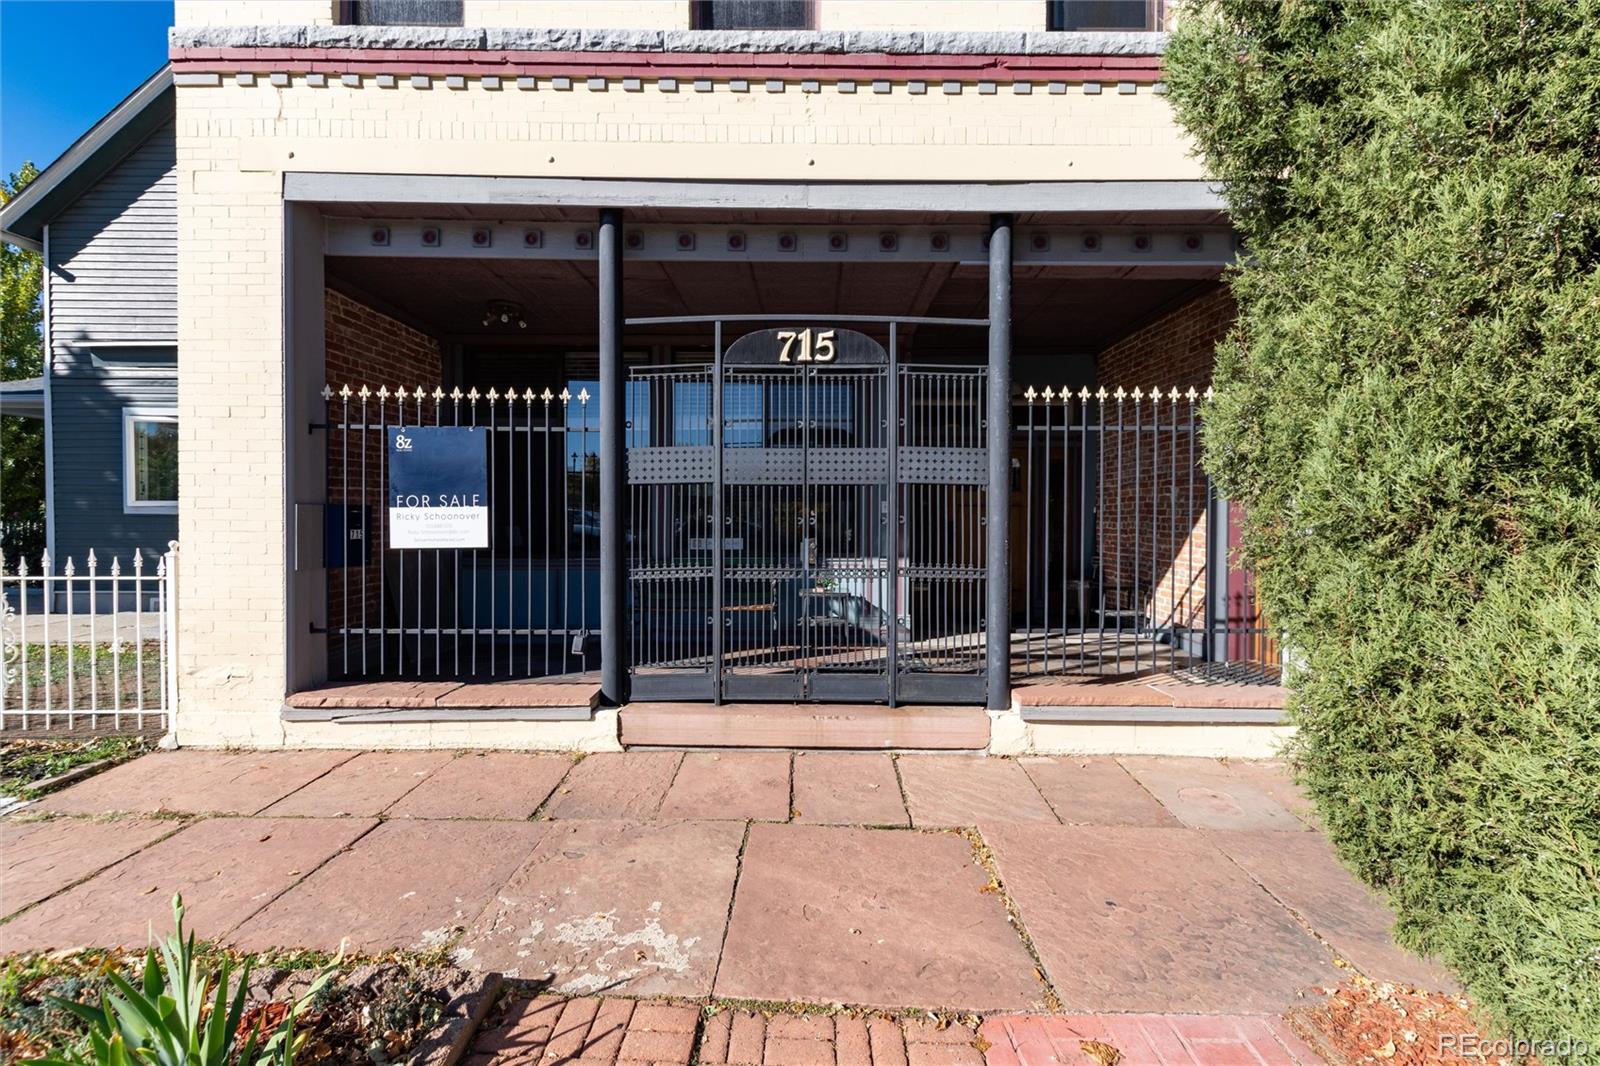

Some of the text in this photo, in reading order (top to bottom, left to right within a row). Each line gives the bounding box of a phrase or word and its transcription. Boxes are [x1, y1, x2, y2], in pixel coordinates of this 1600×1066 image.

[777, 327, 835, 362] 715
[395, 434, 413, 449] 8z
[396, 494, 480, 508] FOR SALE
[396, 513, 480, 521] Ricky Schoonover
